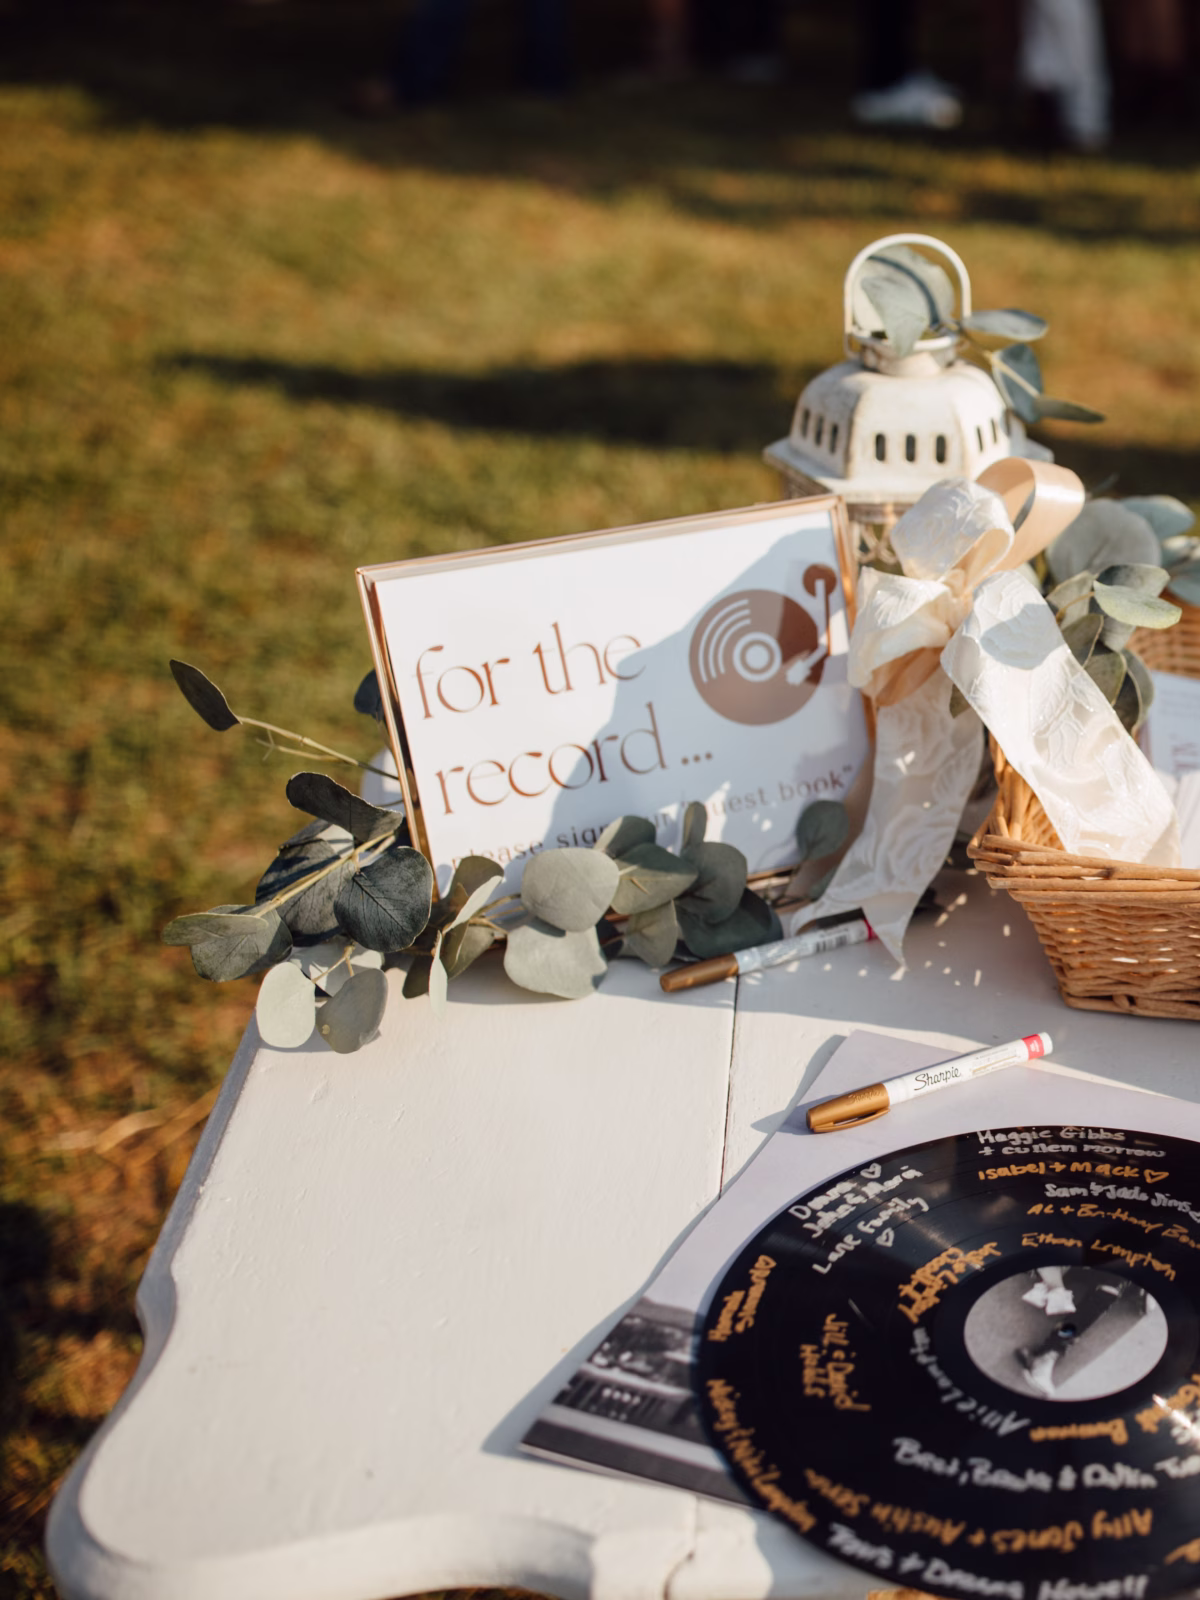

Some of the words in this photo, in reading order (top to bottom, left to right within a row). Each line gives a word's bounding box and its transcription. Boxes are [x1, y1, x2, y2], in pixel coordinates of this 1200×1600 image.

[411, 644, 511, 720] for
[532, 621, 647, 695] the
[913, 1066, 962, 1092] Sharpie
